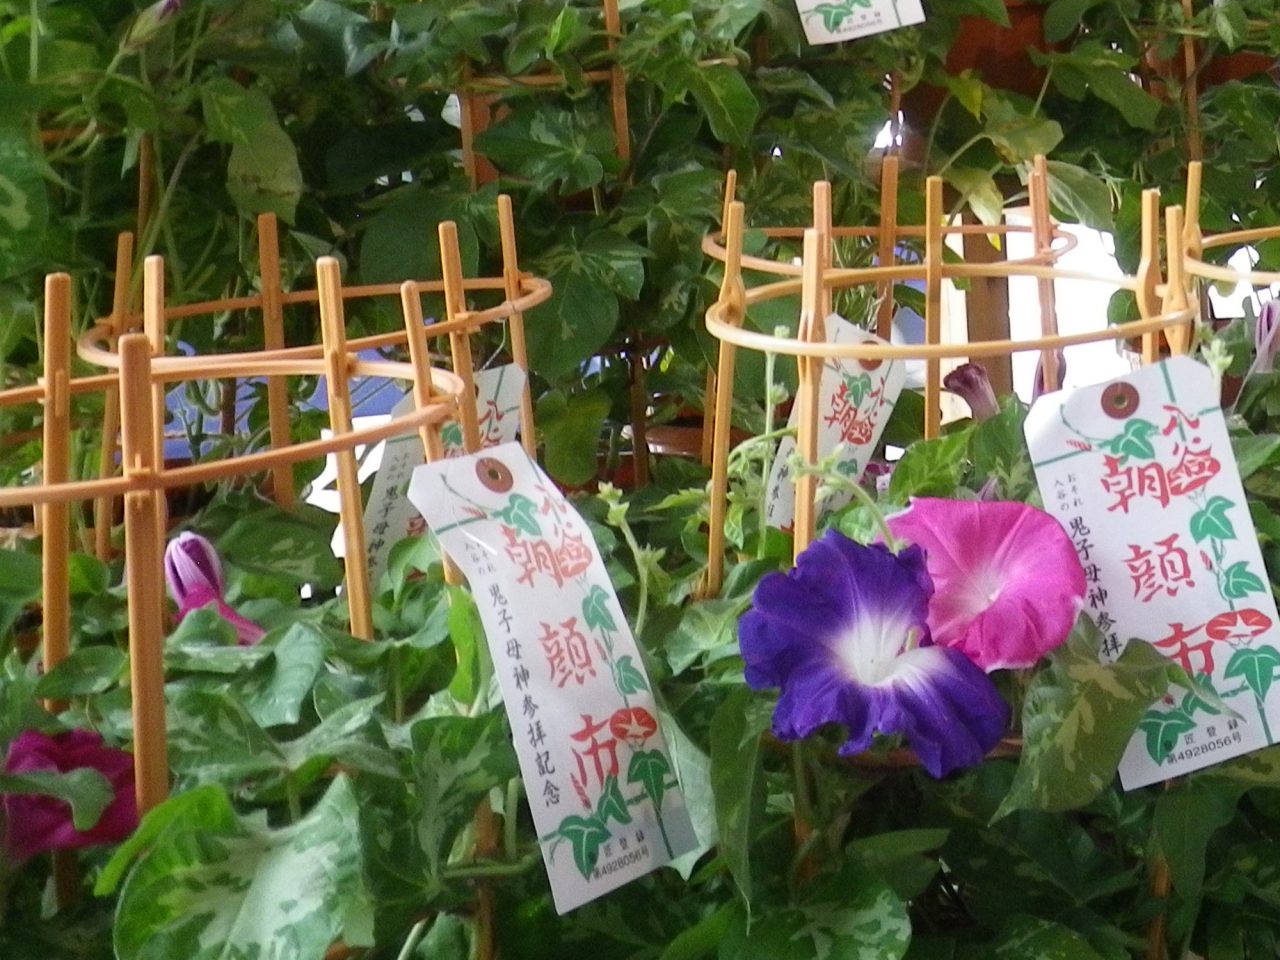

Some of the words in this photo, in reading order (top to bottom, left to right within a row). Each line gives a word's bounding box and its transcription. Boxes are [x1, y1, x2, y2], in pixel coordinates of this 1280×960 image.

[1069, 516, 1123, 658] 鬼子母神参拝
